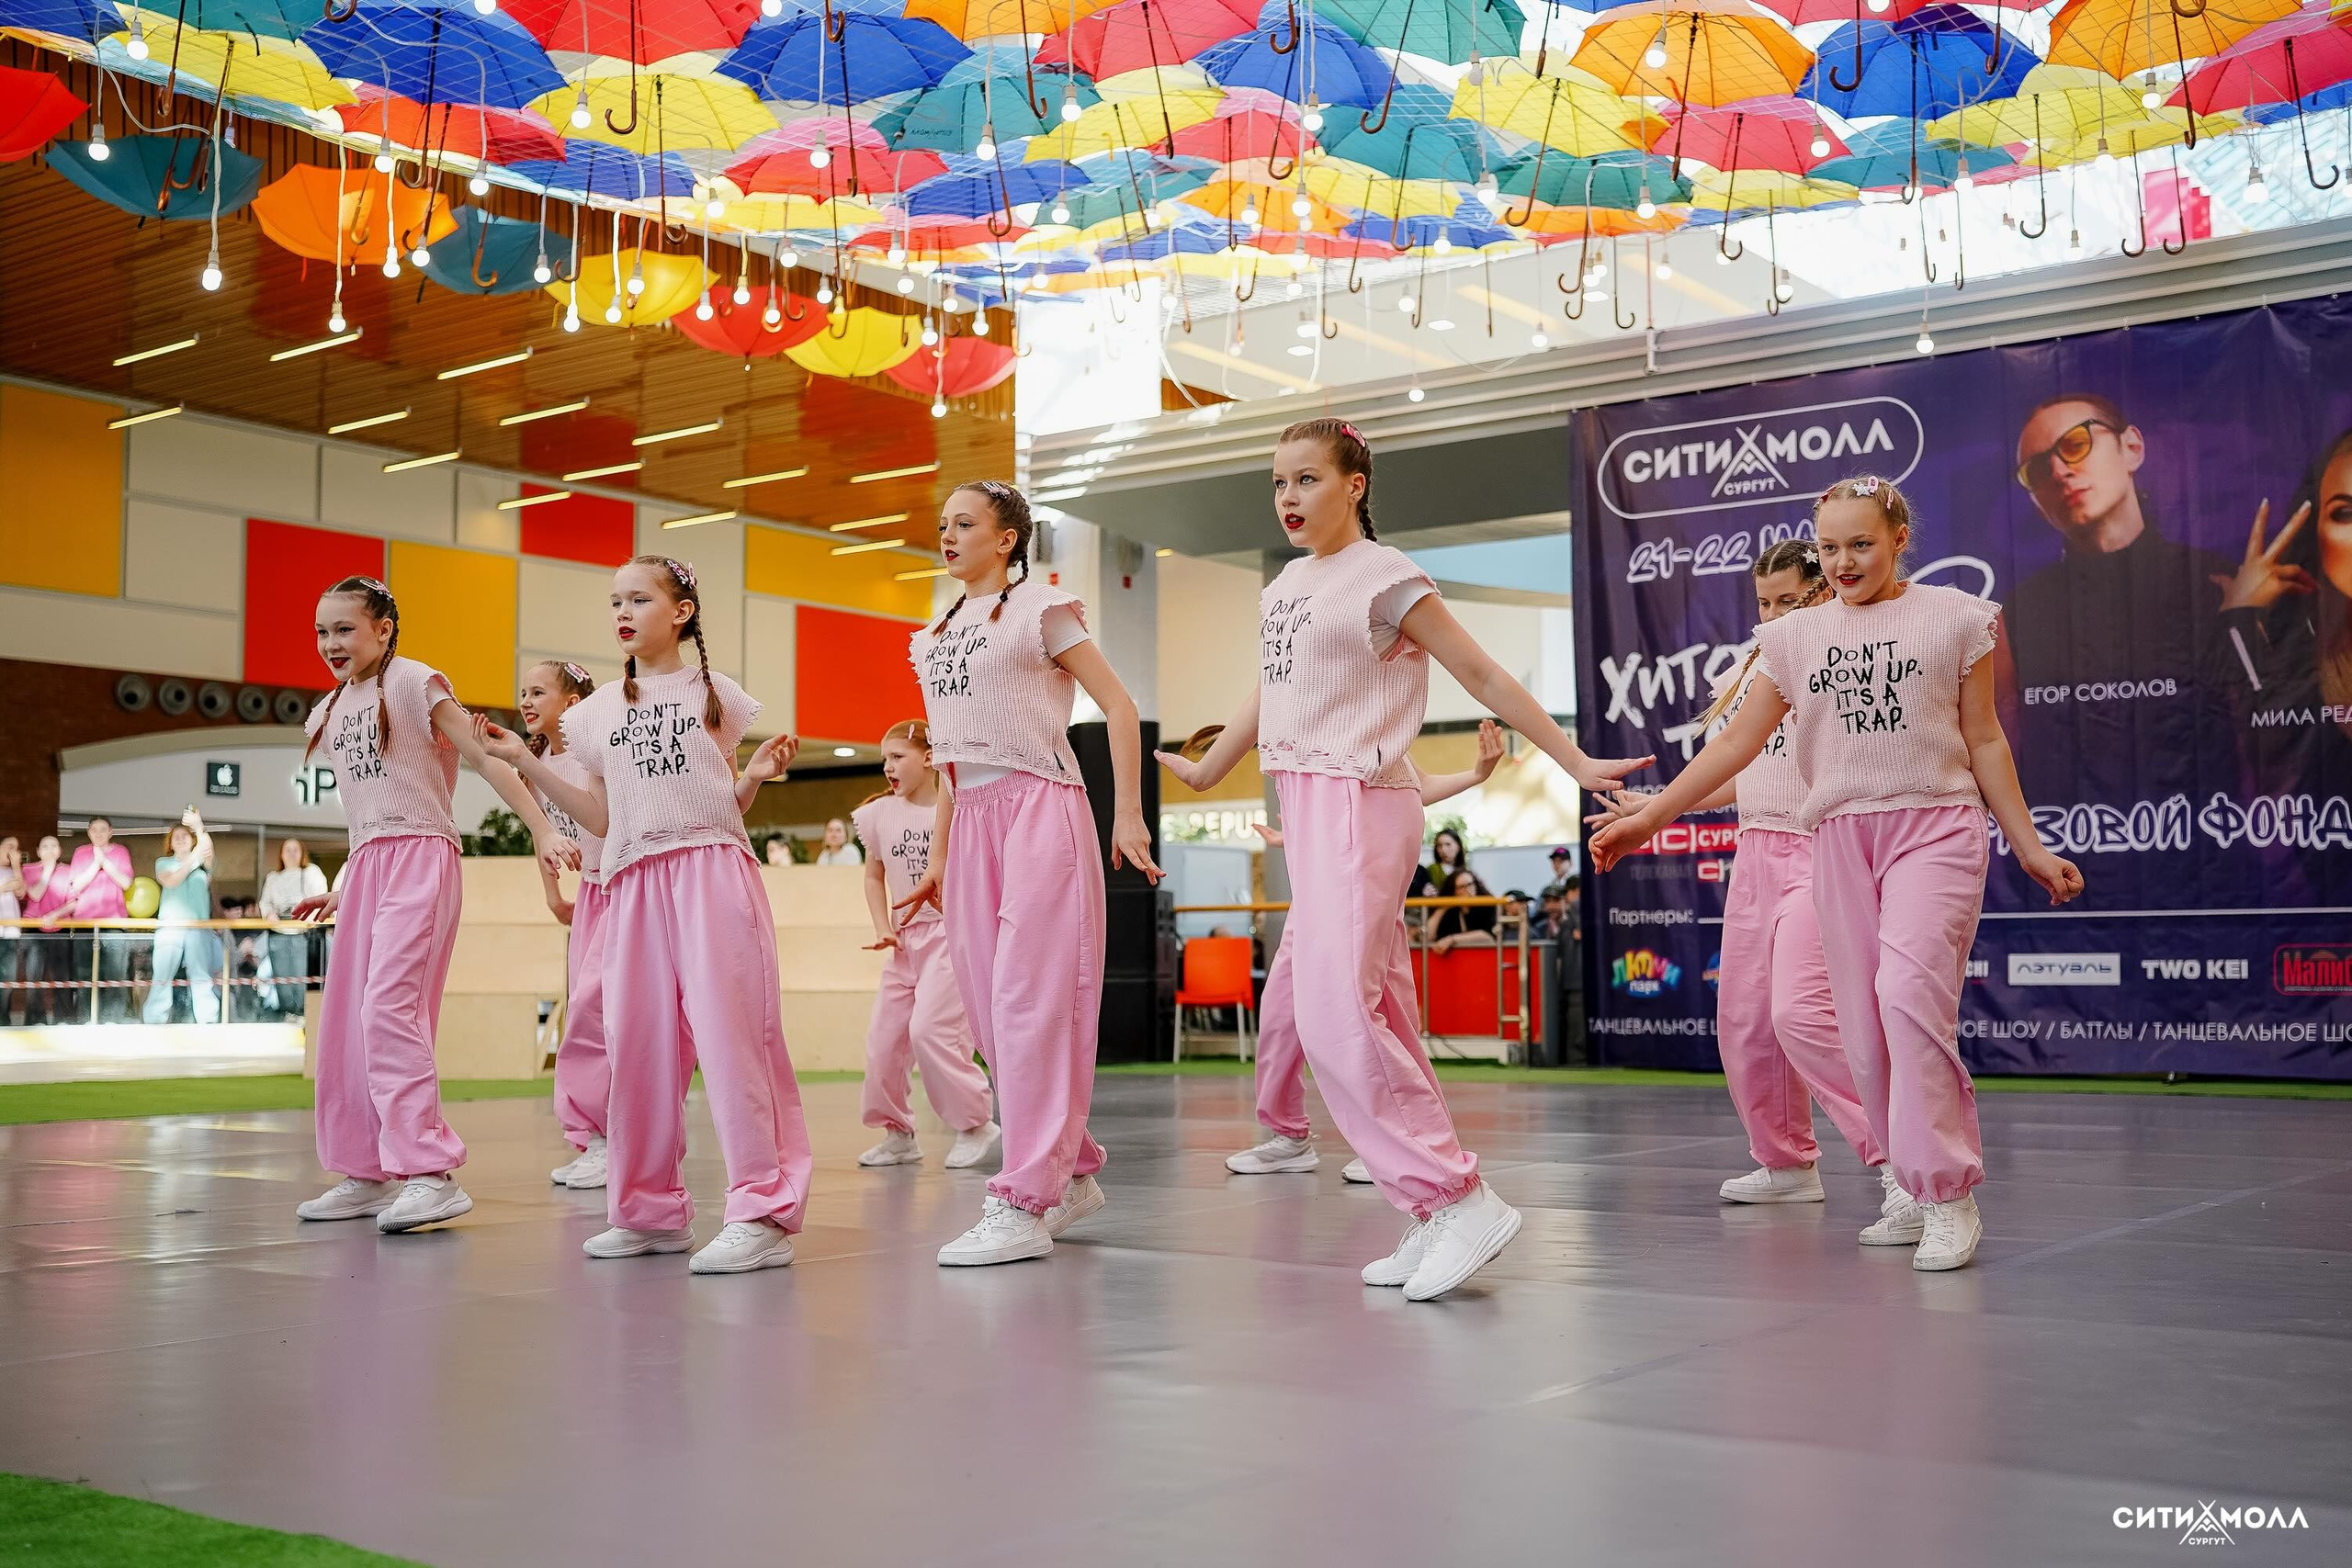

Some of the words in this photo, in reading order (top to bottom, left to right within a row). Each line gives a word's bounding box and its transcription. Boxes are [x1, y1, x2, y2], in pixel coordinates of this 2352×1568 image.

[1623, 438, 1732, 483] СИТИ
[1766, 418, 1895, 463] МОЛЛ
[1723, 477, 1777, 497] СУРГУТ
[1626, 530, 1755, 584] 21-22
[1270, 595, 1312, 617] DON'T
[940, 624, 982, 644] DON'T
[1261, 617, 1289, 639] ROW
[1292, 612, 1311, 633] UP.
[925, 642, 961, 662] GROW
[966, 637, 987, 655] UP.
[1263, 639, 1282, 659] IT'S
[1286, 635, 1293, 656] A
[1827, 641, 1897, 668] DON'T
[930, 660, 953, 677] IT'S
[959, 657, 967, 673] A
[1263, 660, 1293, 685] TRAP.
[1809, 663, 1874, 694] GROW
[1887, 659, 1922, 682] UP.
[931, 675, 971, 698] TRAP.
[1837, 687, 1874, 710] IT'S
[1883, 682, 1899, 706] A
[2024, 685, 2070, 705] ЕГОР
[2075, 678, 2177, 702] СОКОЛОВ
[343, 705, 374, 731] DON'T
[628, 703, 682, 726] DON'T
[1840, 706, 1906, 734] TRAP.
[2251, 707, 2315, 728] МИЛА
[334, 729, 361, 750] GROW
[610, 721, 662, 746] GROW
[673, 717, 700, 735] UP.
[345, 746, 363, 763] IT'S
[368, 742, 378, 758] A
[632, 739, 662, 759] IT'S
[670, 735, 682, 753] A
[349, 760, 387, 782] TRAP.
[635, 754, 689, 778] TRAP.
[2199, 792, 2352, 851] ФОНД
[904, 829, 933, 843] DON'
[891, 844, 929, 857] GROW
[907, 859, 928, 870] IT'S
[1609, 908, 1694, 928] Партнеры:
[2141, 959, 2201, 980] TWO
[2207, 959, 2249, 980] KEI
[1589, 1017, 1707, 1036] ТАНЦЕВАЛЬНОЕ
[1993, 1020, 2041, 1039] ШОУ
[2060, 1021, 2133, 1040] БАТТЛЫ
[2154, 1022, 2317, 1043] ТАНЦЕВАЛЬНОЕ
